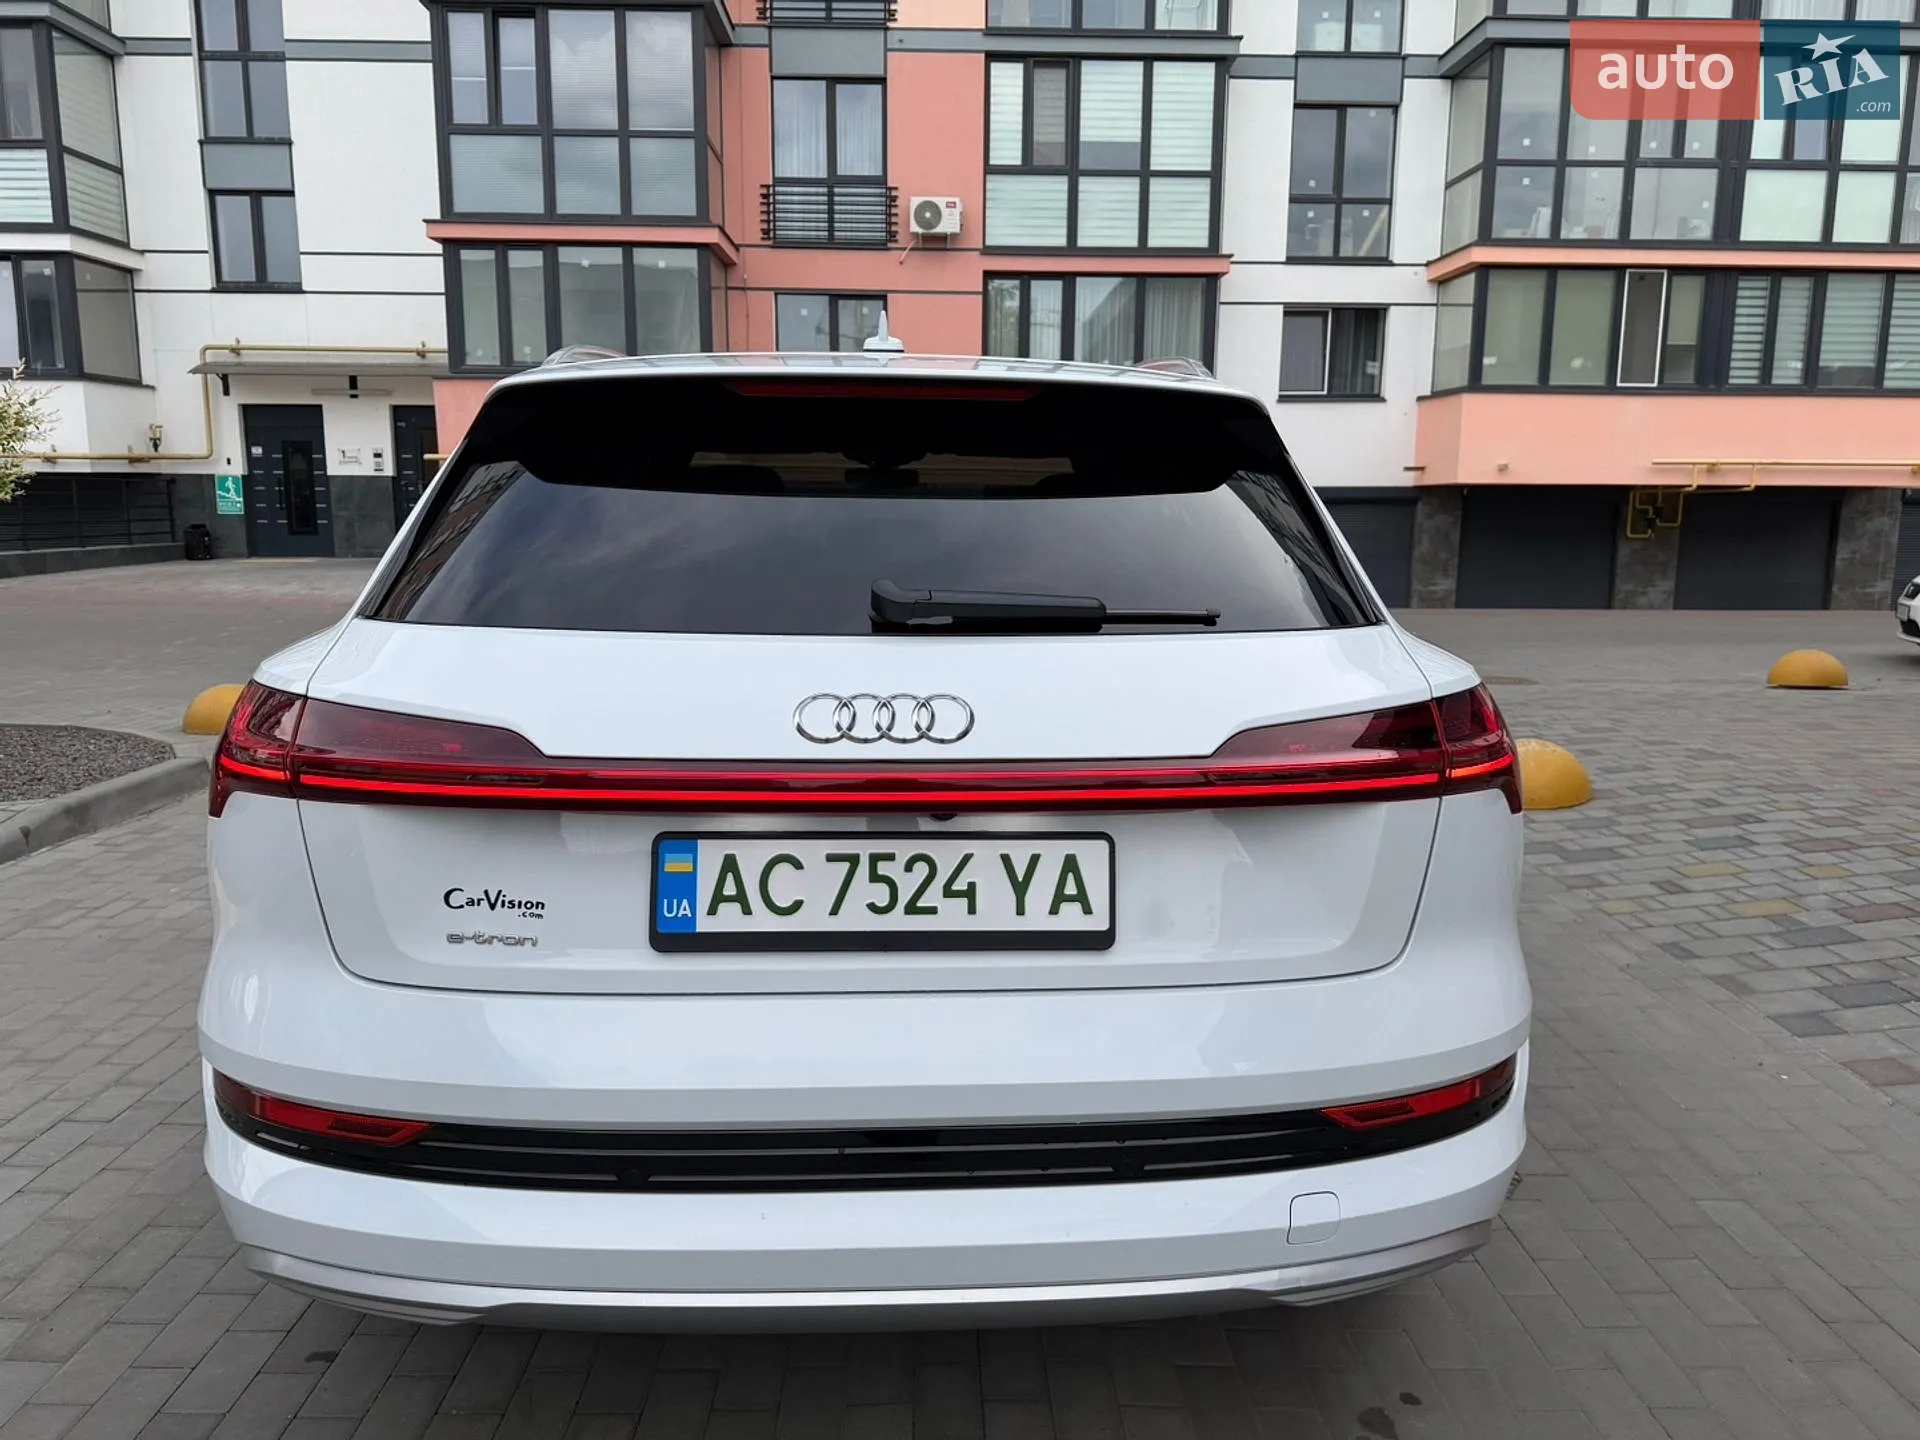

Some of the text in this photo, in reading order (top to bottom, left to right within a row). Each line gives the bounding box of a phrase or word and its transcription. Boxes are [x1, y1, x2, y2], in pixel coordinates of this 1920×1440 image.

[706, 852, 1094, 916] AC 7524 YA
[443, 887, 545, 911] CarVision
[663, 898, 692, 918] UA
[517, 911, 544, 920] .com
[446, 931, 538, 947] e-tron
